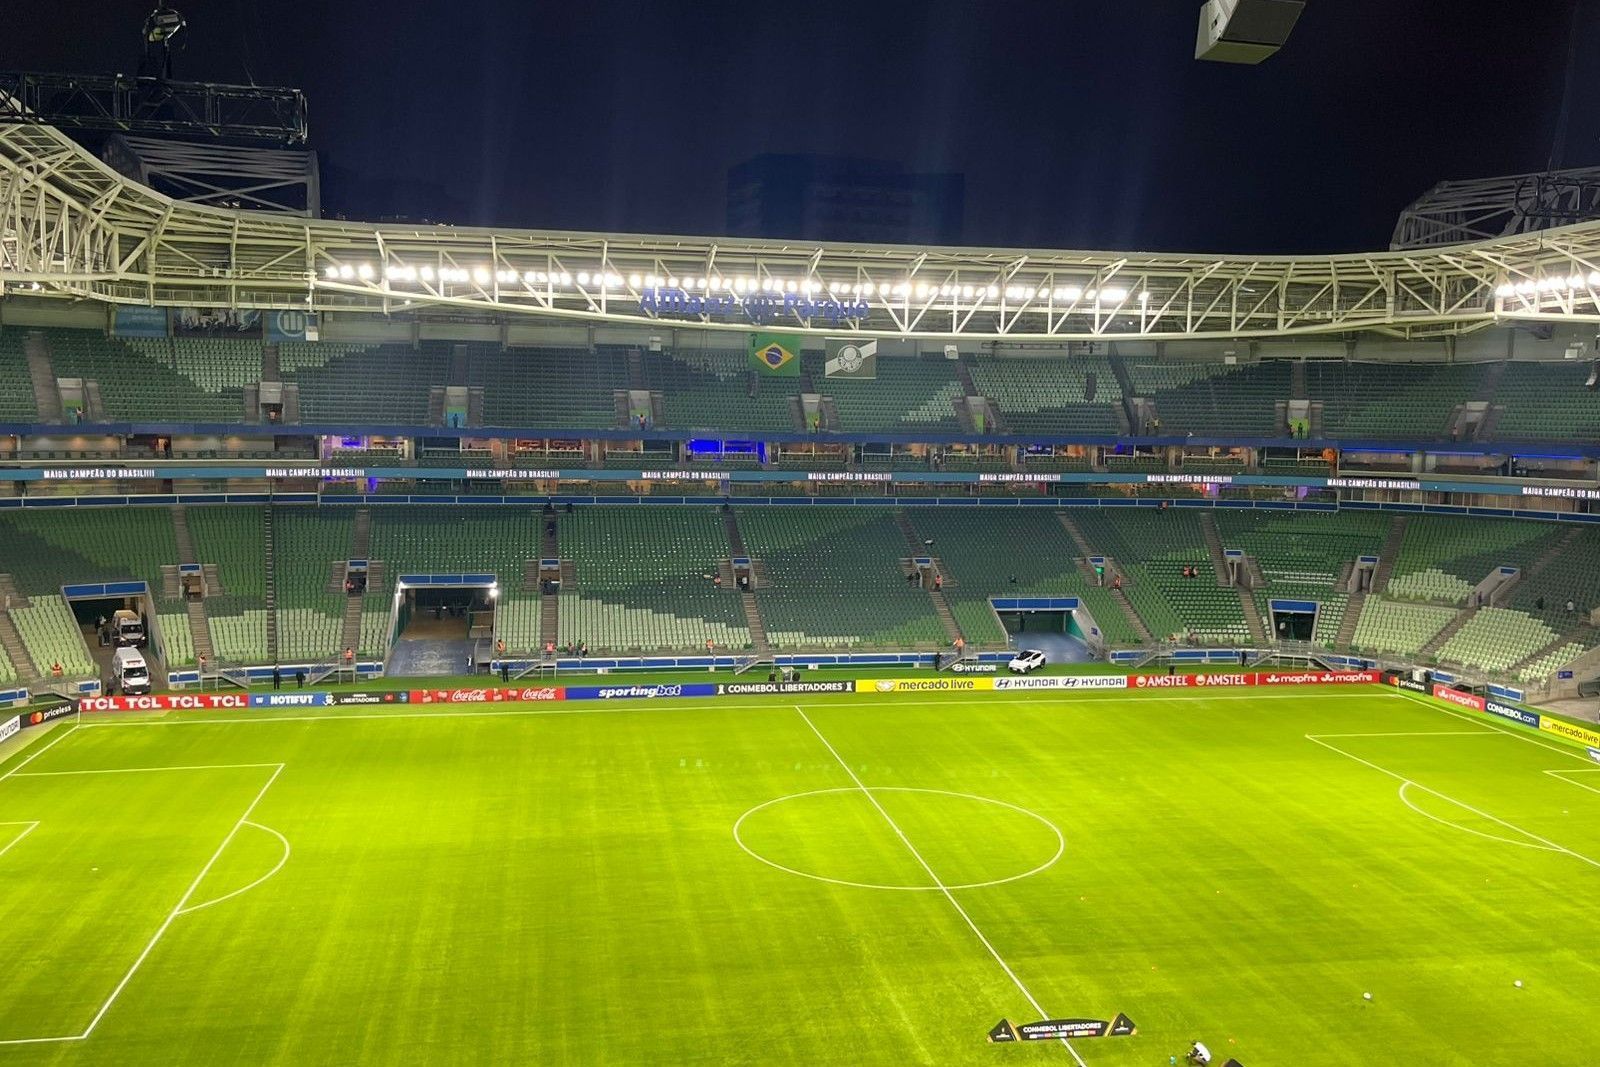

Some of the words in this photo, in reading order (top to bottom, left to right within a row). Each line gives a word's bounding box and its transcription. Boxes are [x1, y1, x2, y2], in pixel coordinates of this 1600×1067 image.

[44, 470, 68, 479] MAIOR
[70, 468, 104, 478] CAMPEÃO
[106, 470, 117, 478] DO
[266, 469, 287, 477] MAIOR
[288, 467, 320, 477] CAMPEÃO
[321, 469, 331, 477] DO
[466, 470, 487, 478] MAIOR
[488, 469, 517, 478] CAMPEÃO
[518, 470, 527, 478] DO
[662, 470, 690, 479] CAMPEÃO
[827, 472, 854, 480] CAMPEÃO
[980, 473, 997, 481] MAIOR
[998, 472, 1024, 481] CAMPEÃO
[1024, 473, 1033, 481] DO
[1146, 474, 1164, 482] MAIOR
[1165, 474, 1192, 482] CAMPEÃO
[1327, 479, 1347, 487] MAIOR
[1348, 479, 1377, 488] CAMPEÃO
[1522, 487, 1543, 495] MAIOR
[1544, 487, 1575, 497] CAMPEÃO
[1576, 489, 1586, 498] DO
[1081, 678, 1125, 686] HYUNDAI
[1147, 675, 1188, 686] AMSTEL
[1206, 674, 1247, 685] AMSTEL
[1280, 674, 1318, 684] mapfre
[1335, 672, 1373, 683] mapfre
[728, 683, 779, 694] CONMEBOL
[780, 682, 843, 692] LIBERTADORES
[899, 679, 949, 690] mercado
[950, 678, 974, 689] livre
[598, 684, 682, 698] sportingbet
[82, 698, 119, 710] TCL
[125, 697, 162, 709] TCL
[168, 696, 204, 708] TCL
[210, 695, 246, 707] TCL
[270, 695, 313, 705] NOTIFUT
[44, 704, 71, 720] priceless
[1552, 723, 1582, 738] mercado
[1583, 732, 1599, 744] livre
[1022, 1025, 1058, 1033] CONMEBOL
[1058, 1022, 1102, 1031] LIBERTADORES
